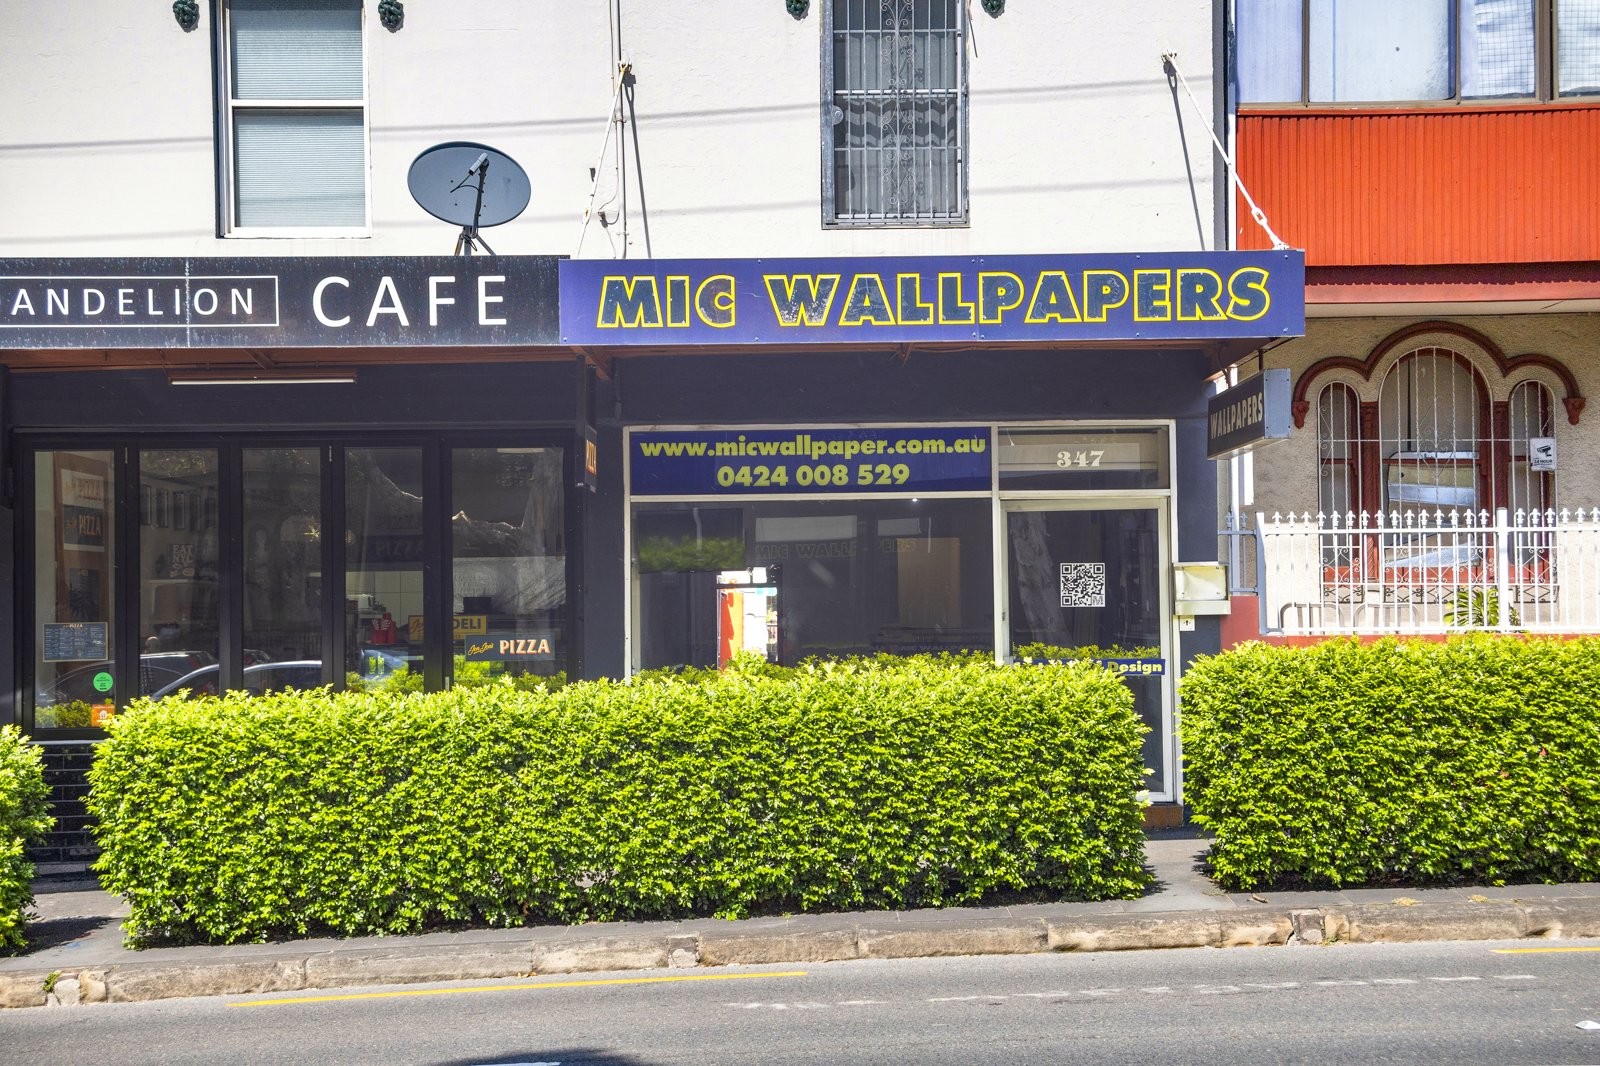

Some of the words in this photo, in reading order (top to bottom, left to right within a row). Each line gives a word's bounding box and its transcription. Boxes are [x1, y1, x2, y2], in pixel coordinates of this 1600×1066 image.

[10, 287, 254, 316] ANDELION
[312, 275, 508, 328] CAFE
[596, 274, 736, 328] MIC
[763, 266, 1271, 327] WALLPAPERS
[1210, 392, 1264, 440] WALLPAPERS
[640, 435, 986, 460] www.micwallpaper.com.au
[1056, 450, 1105, 468] 347
[717, 465, 789, 487] 0424
[796, 464, 849, 486] 008
[857, 463, 910, 485] 529
[500, 639, 550, 655] PIZZA
[1107, 660, 1162, 675] Design
